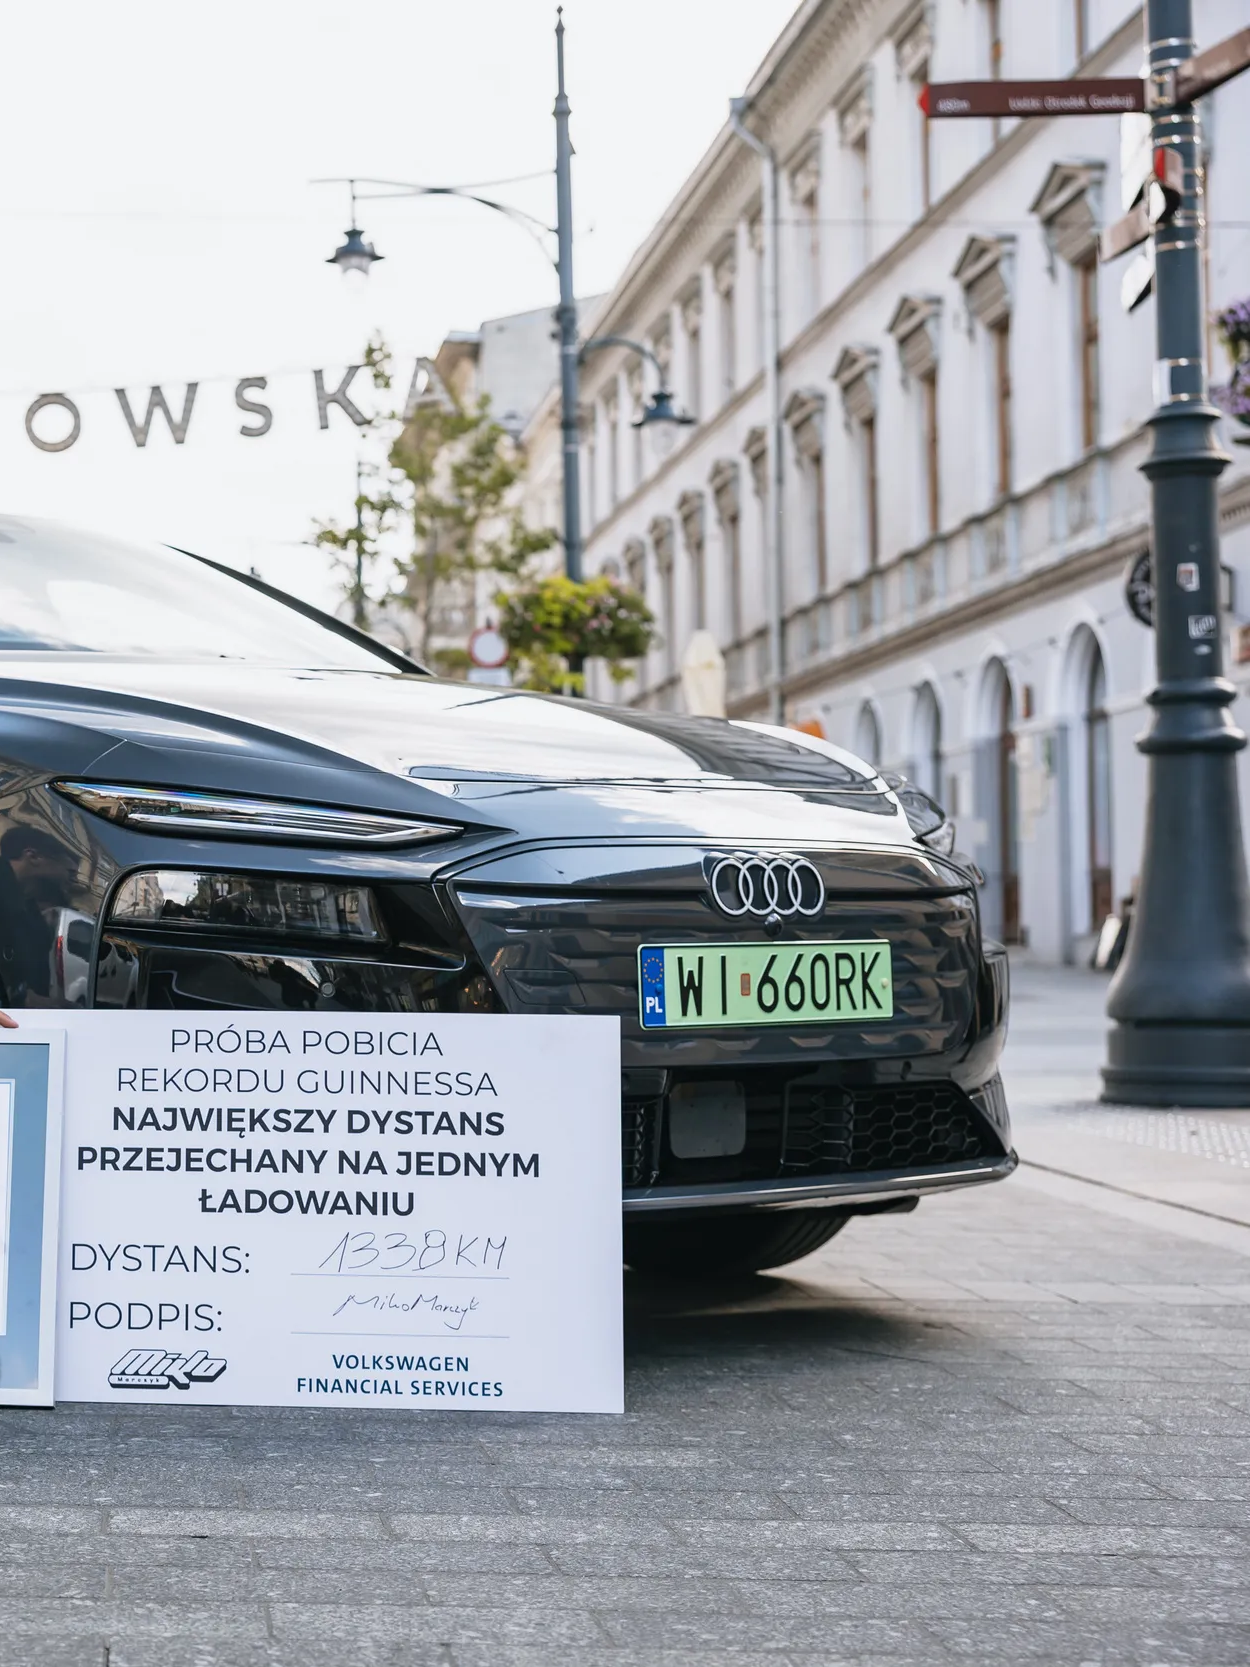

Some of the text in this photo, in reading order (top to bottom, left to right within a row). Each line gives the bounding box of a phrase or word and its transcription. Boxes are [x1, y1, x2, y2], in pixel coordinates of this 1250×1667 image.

[677, 951, 883, 1017] WI 660RK
[646, 996, 663, 1014] PL
[171, 1024, 444, 1056] PRÓBA POBICIA
[118, 1067, 498, 1096] REKORDU GUINNESSA
[113, 1106, 505, 1138] NAJWIĘKSZY DYSTANS
[77, 1146, 540, 1178] PRZEJECHANY NA JEDNYM
[198, 1188, 415, 1216] ŁADOWANIU
[71, 1243, 250, 1274] DYSTANS:
[69, 1302, 222, 1332] PODPIS:
[332, 1354, 470, 1373] VOLKSWAGEN
[296, 1377, 504, 1398] FINANCIAL SERVICES
